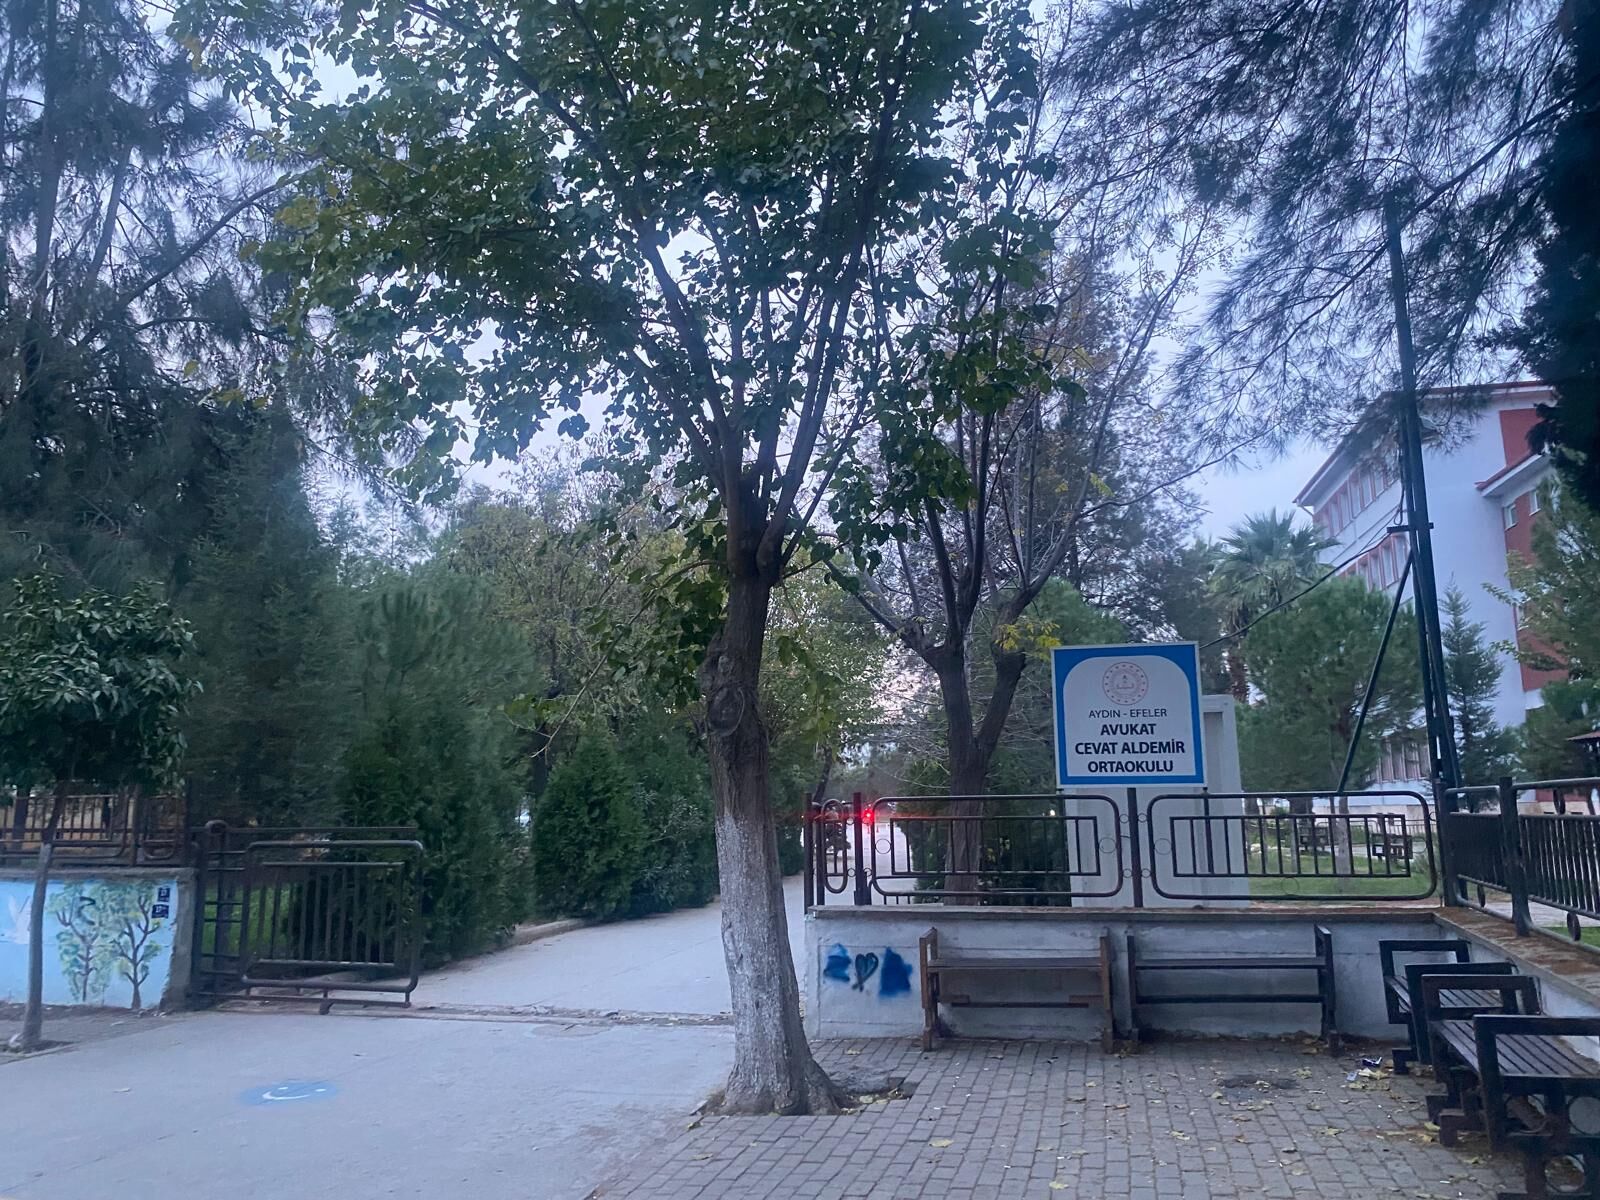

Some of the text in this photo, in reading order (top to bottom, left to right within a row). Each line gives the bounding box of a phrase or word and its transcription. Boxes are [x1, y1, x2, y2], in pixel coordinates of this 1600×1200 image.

[1088, 710, 1121, 718] AYDIN
[1129, 708, 1168, 718] EFELER
[1100, 723, 1157, 736] AVUKAT
[1074, 738, 1185, 755] CEVAT ALDEMİR
[1087, 760, 1173, 773] ORTAOKULU
